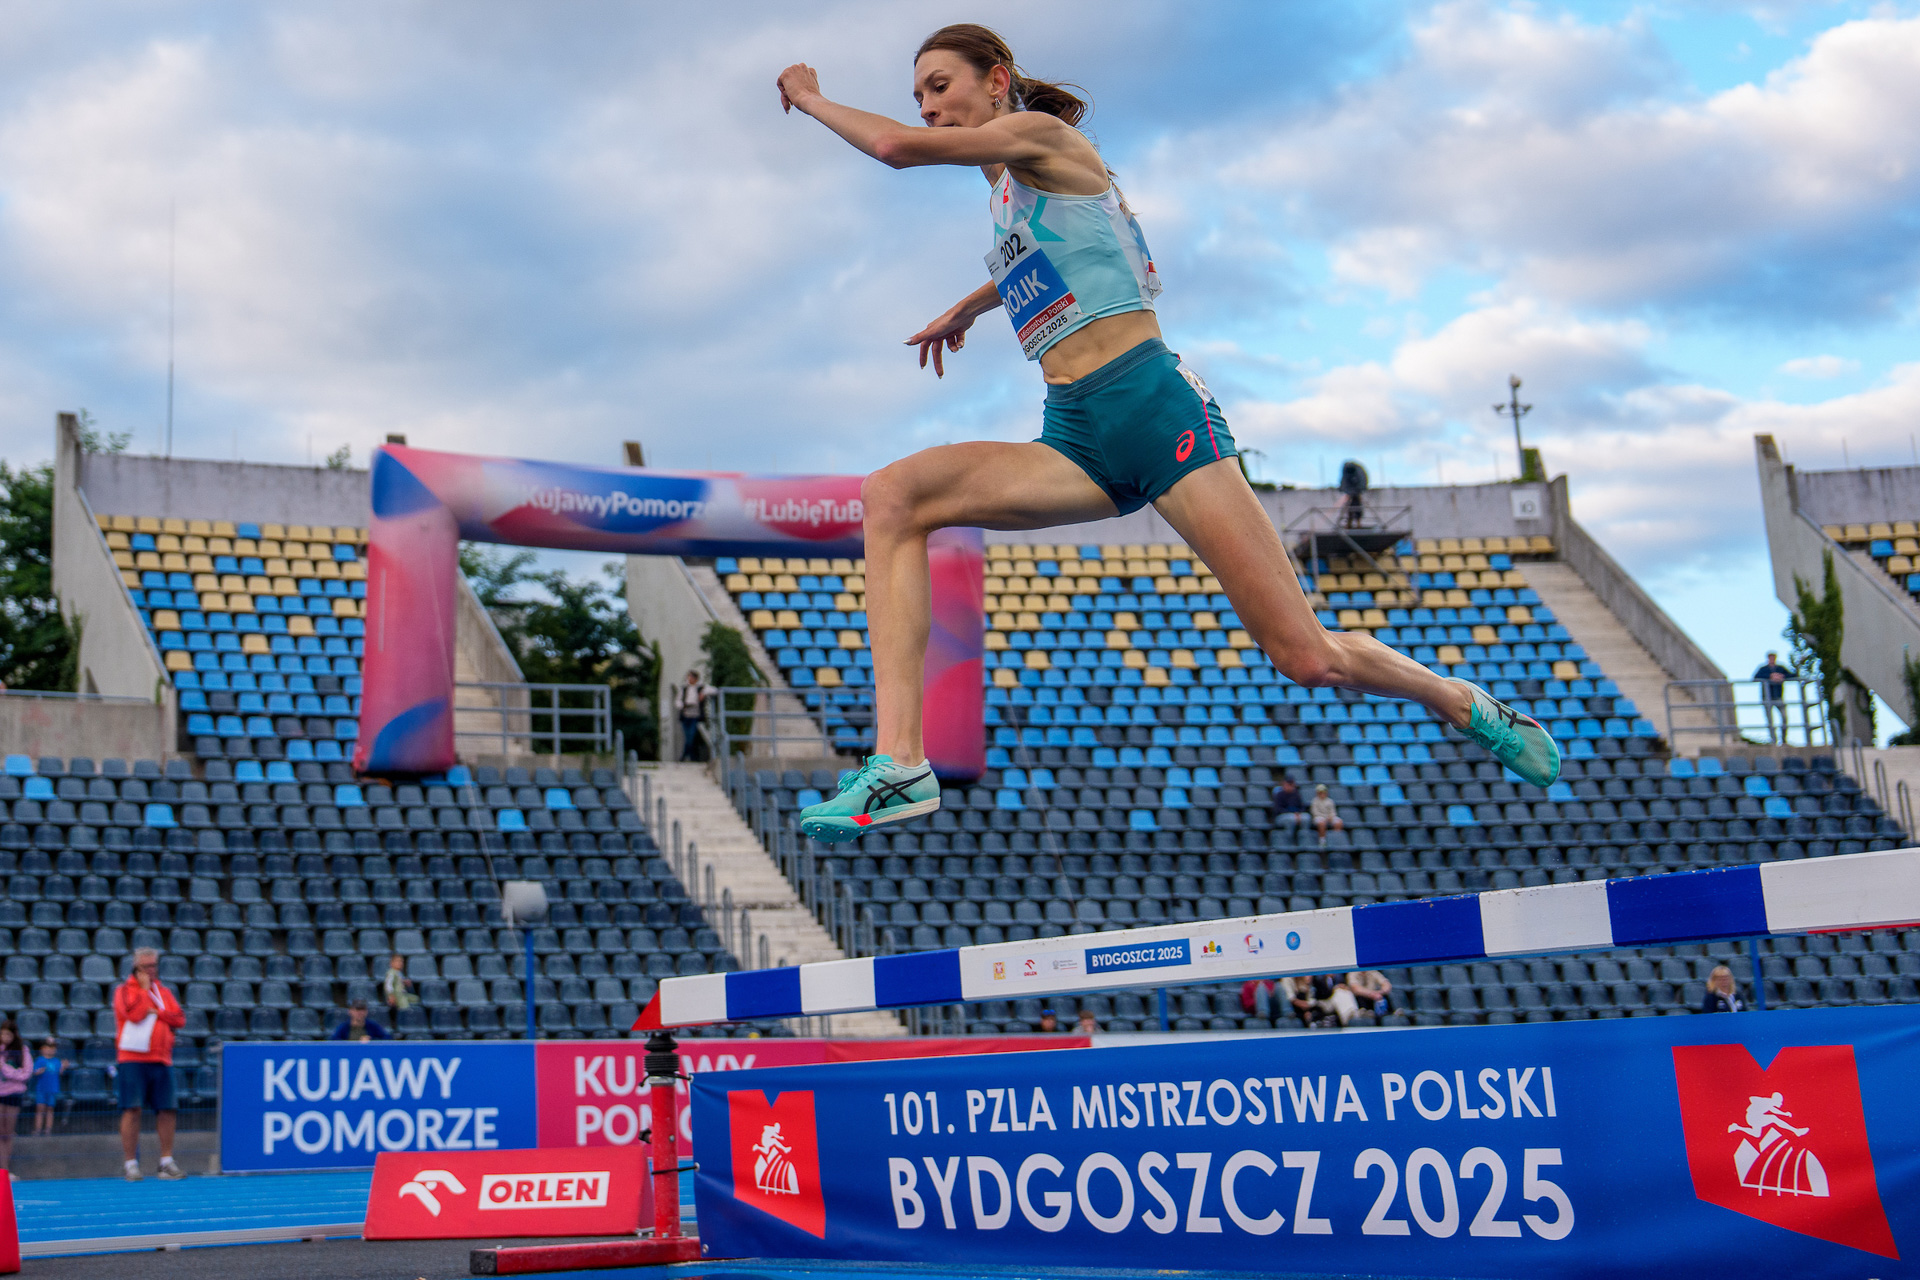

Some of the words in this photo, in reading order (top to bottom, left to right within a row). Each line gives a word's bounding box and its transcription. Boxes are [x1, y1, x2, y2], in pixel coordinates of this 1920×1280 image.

[1000, 232, 1028, 268] 202
[1046, 314, 1068, 334] 2025
[1047, 297, 1069, 317] Polski
[1092, 949, 1155, 967] BYDGOSZCZ
[1157, 946, 1183, 961] 2025
[263, 1057, 461, 1101] KUJAWY
[884, 1092, 954, 1135] 101.
[967, 1087, 1056, 1132] PZLA
[1073, 1075, 1368, 1128] MISTRZOSTWA
[1382, 1067, 1556, 1120] POLSKI
[263, 1107, 499, 1155] POMORZE
[488, 1177, 600, 1203] ORLEN
[889, 1150, 1332, 1235] BYDGOSZCZ
[1354, 1147, 1574, 1240] 2025
